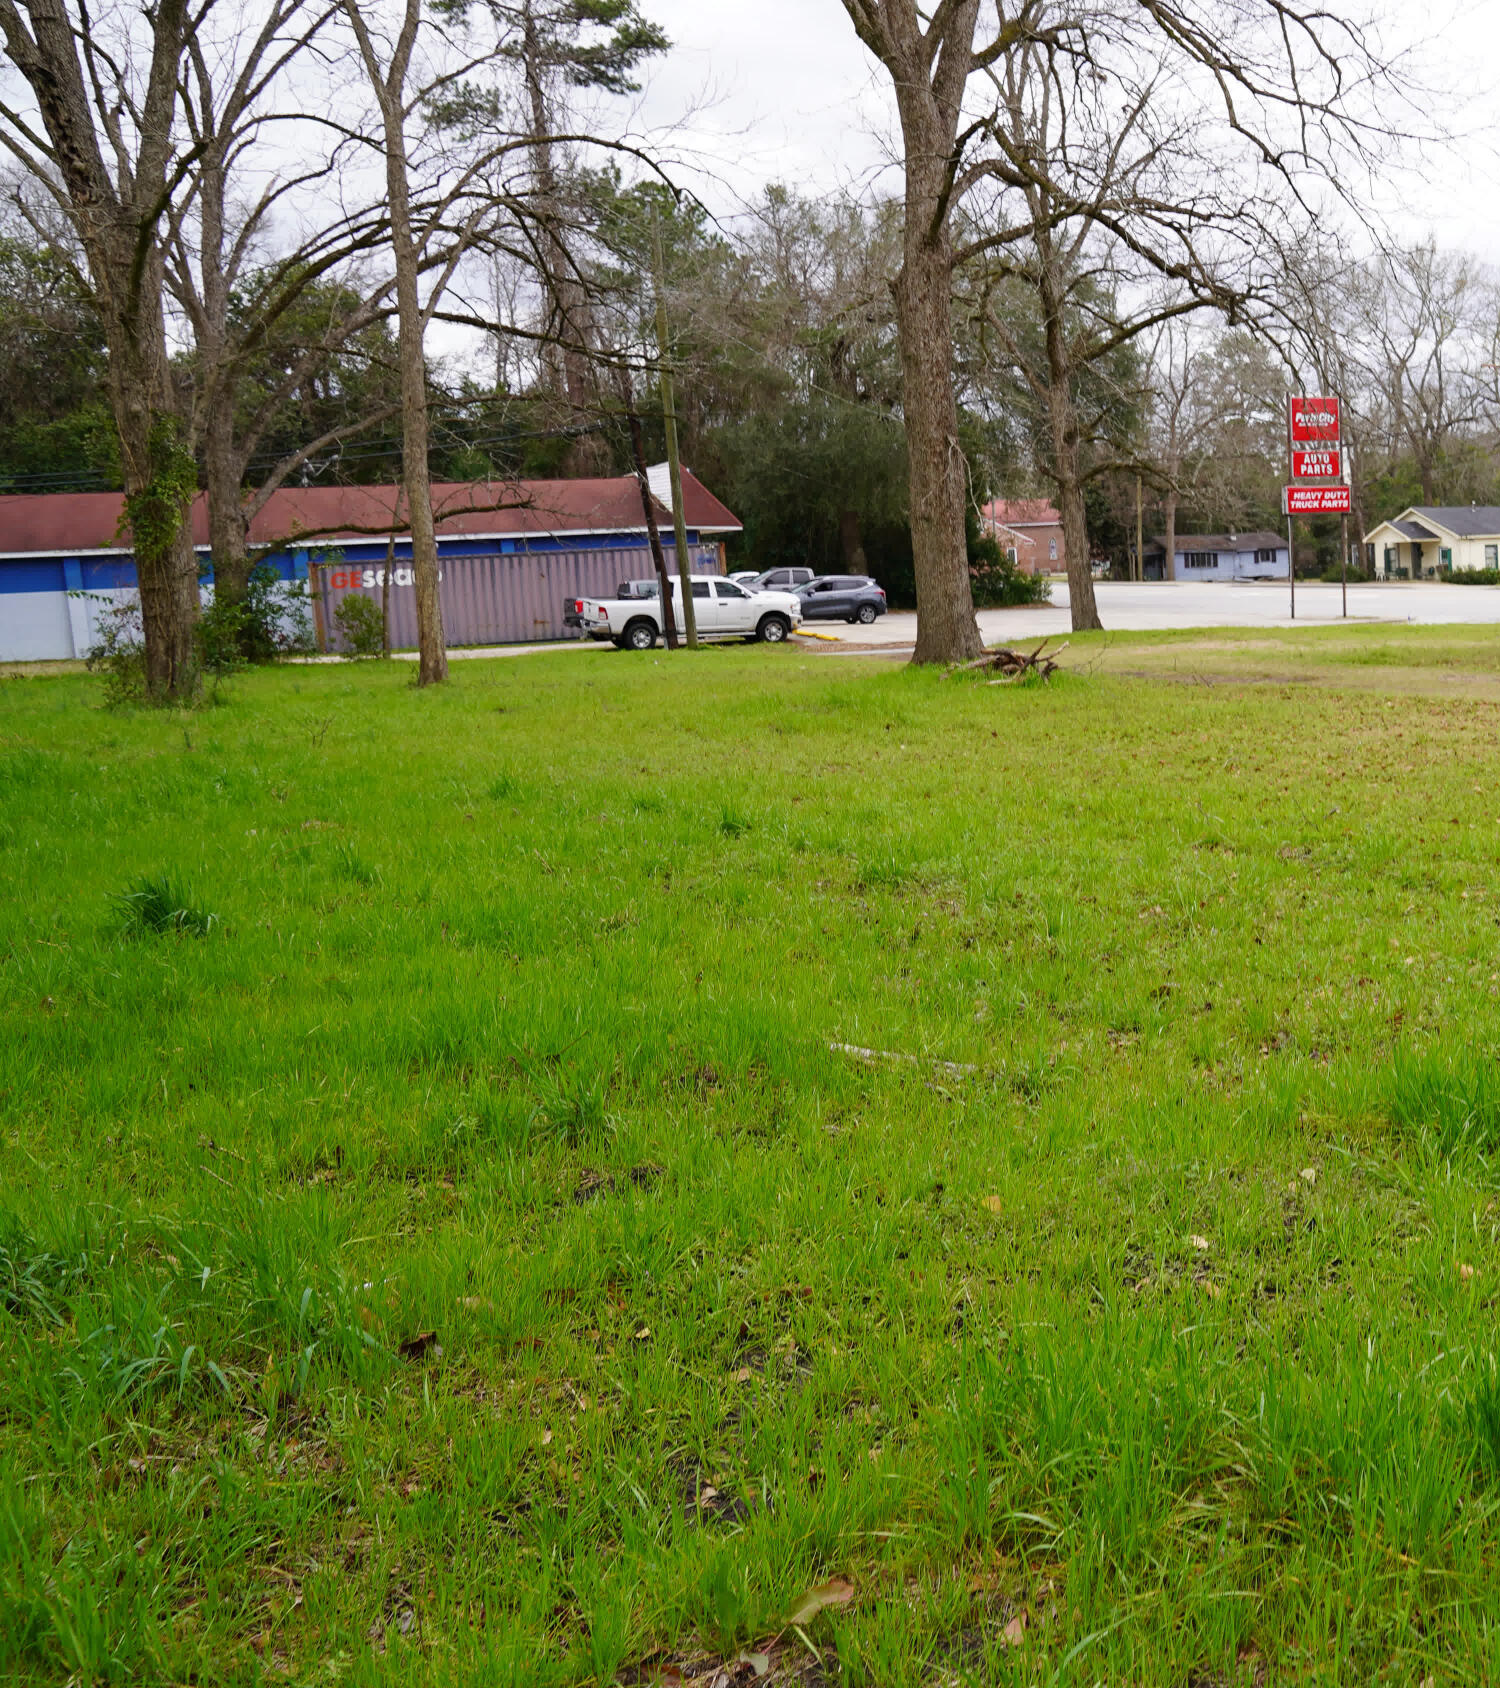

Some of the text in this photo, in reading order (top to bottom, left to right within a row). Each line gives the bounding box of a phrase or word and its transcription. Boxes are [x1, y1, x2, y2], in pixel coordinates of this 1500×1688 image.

[1304, 454, 1329, 464] AUTO
[1301, 464, 1332, 474] PARTS
[1293, 491, 1348, 500] HEAVY DUTY
[1290, 500, 1349, 509] TRUCK PARTS
[330, 569, 442, 589] GEsea
